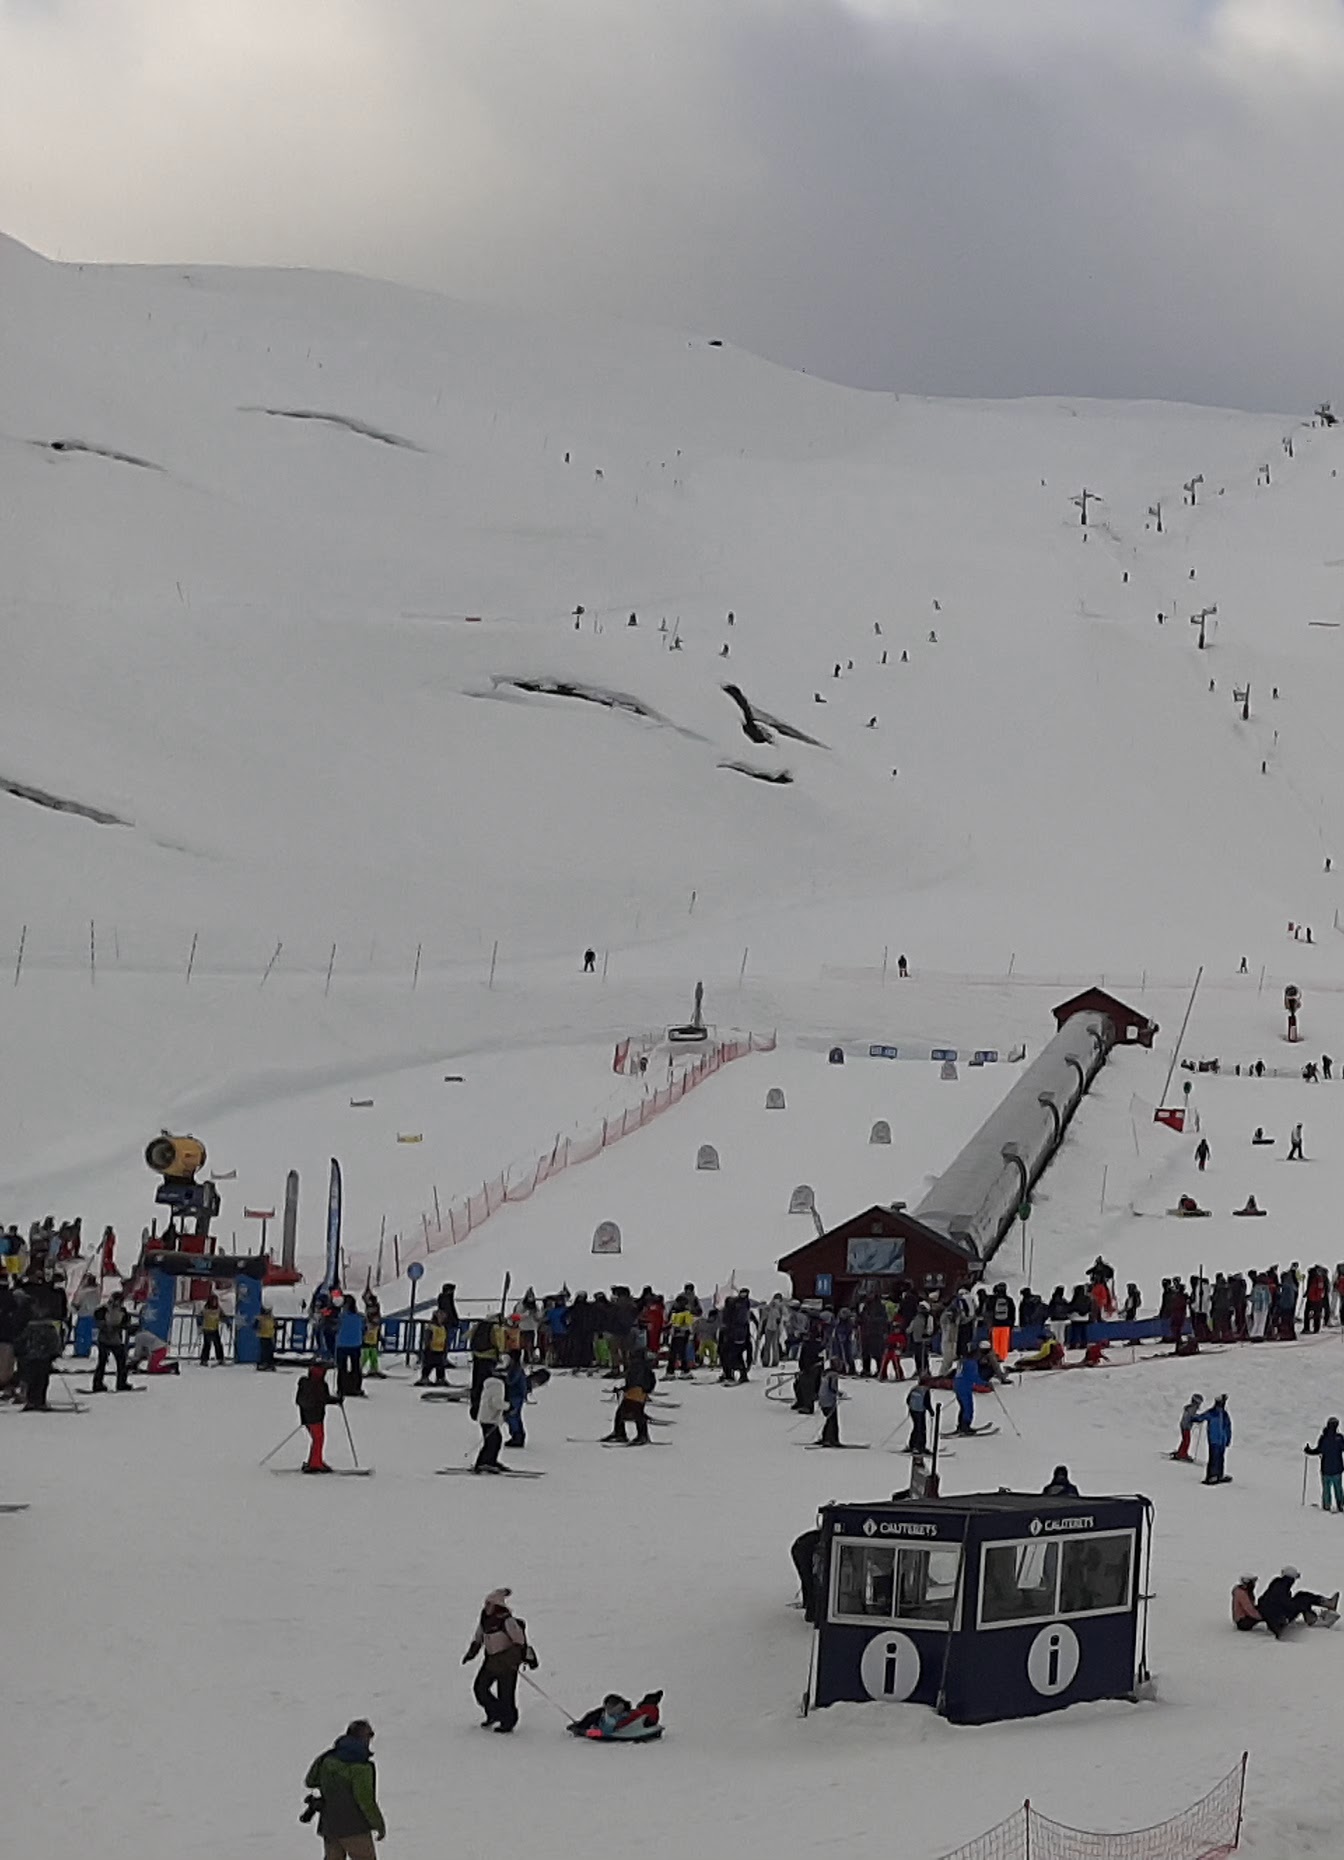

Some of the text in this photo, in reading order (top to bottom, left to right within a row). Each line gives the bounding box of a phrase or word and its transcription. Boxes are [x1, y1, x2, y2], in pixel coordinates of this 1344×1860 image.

[880, 1522, 938, 1537] CAUTERETS
[883, 1642, 898, 1695] i
[1047, 1634, 1060, 1686] i
